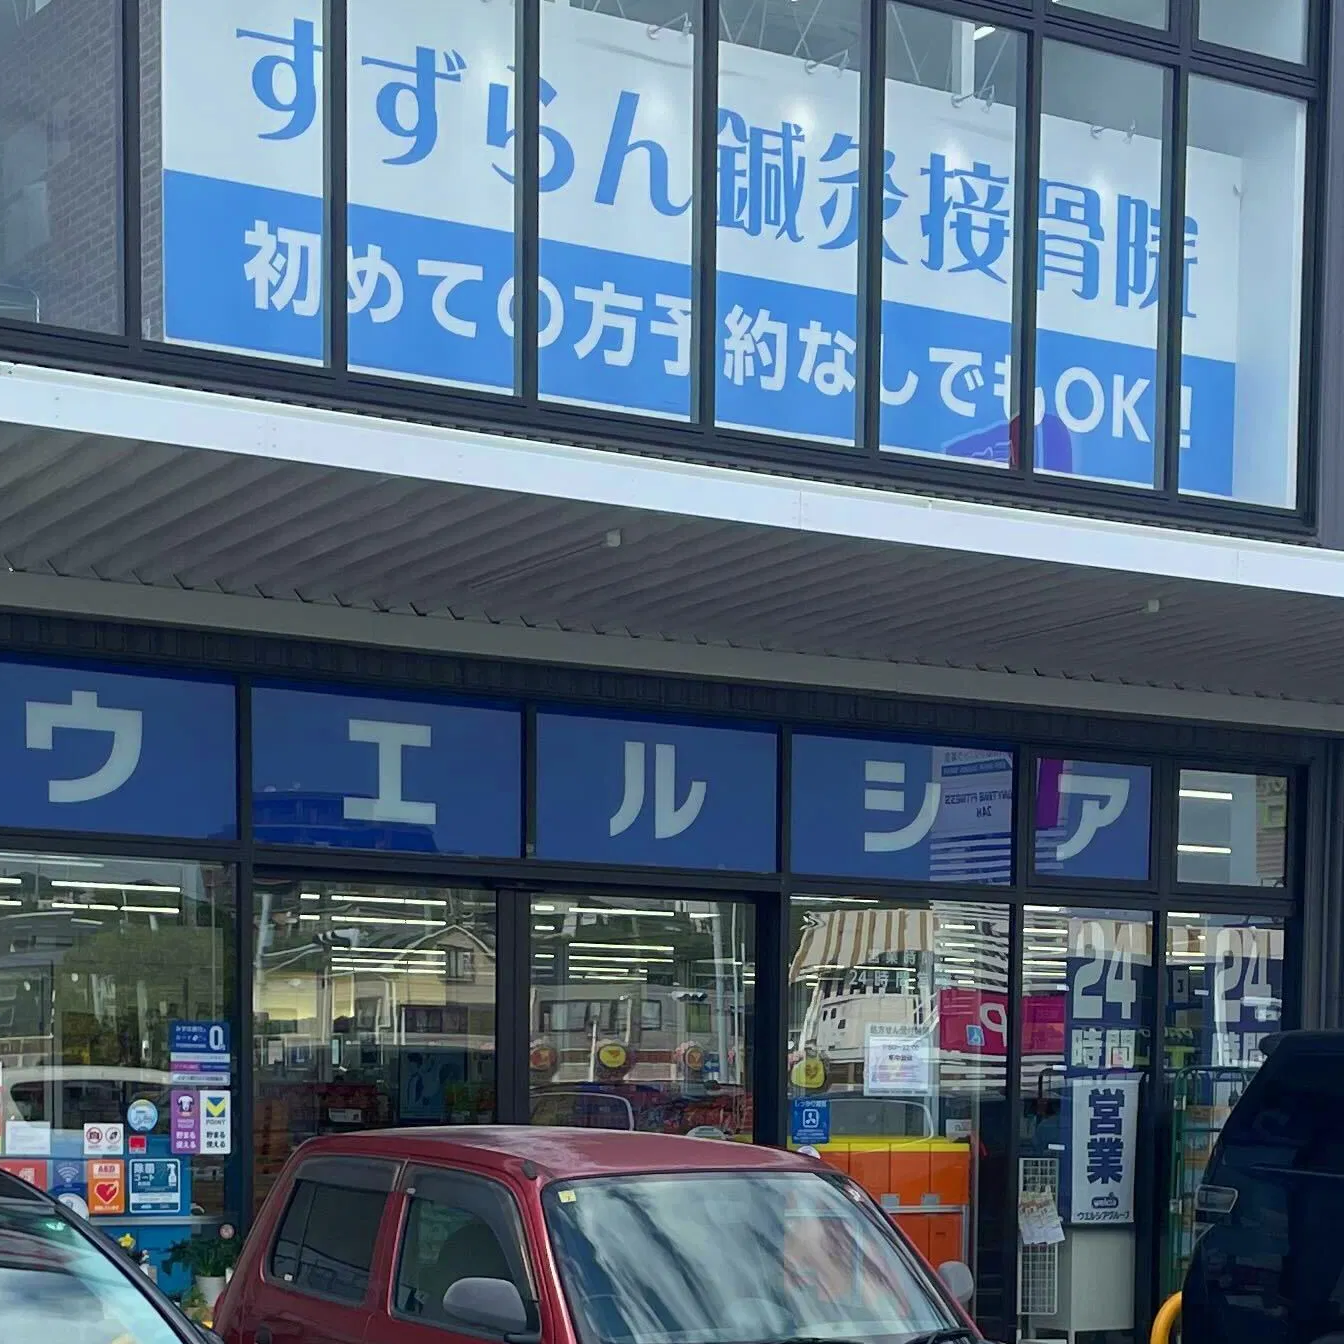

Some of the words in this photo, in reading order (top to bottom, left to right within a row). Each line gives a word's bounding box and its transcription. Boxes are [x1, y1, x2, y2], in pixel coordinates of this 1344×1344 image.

[1073, 921, 1137, 1019] 24
[1215, 926, 1272, 1023] 24
[1087, 1089, 1124, 1184] 営業
